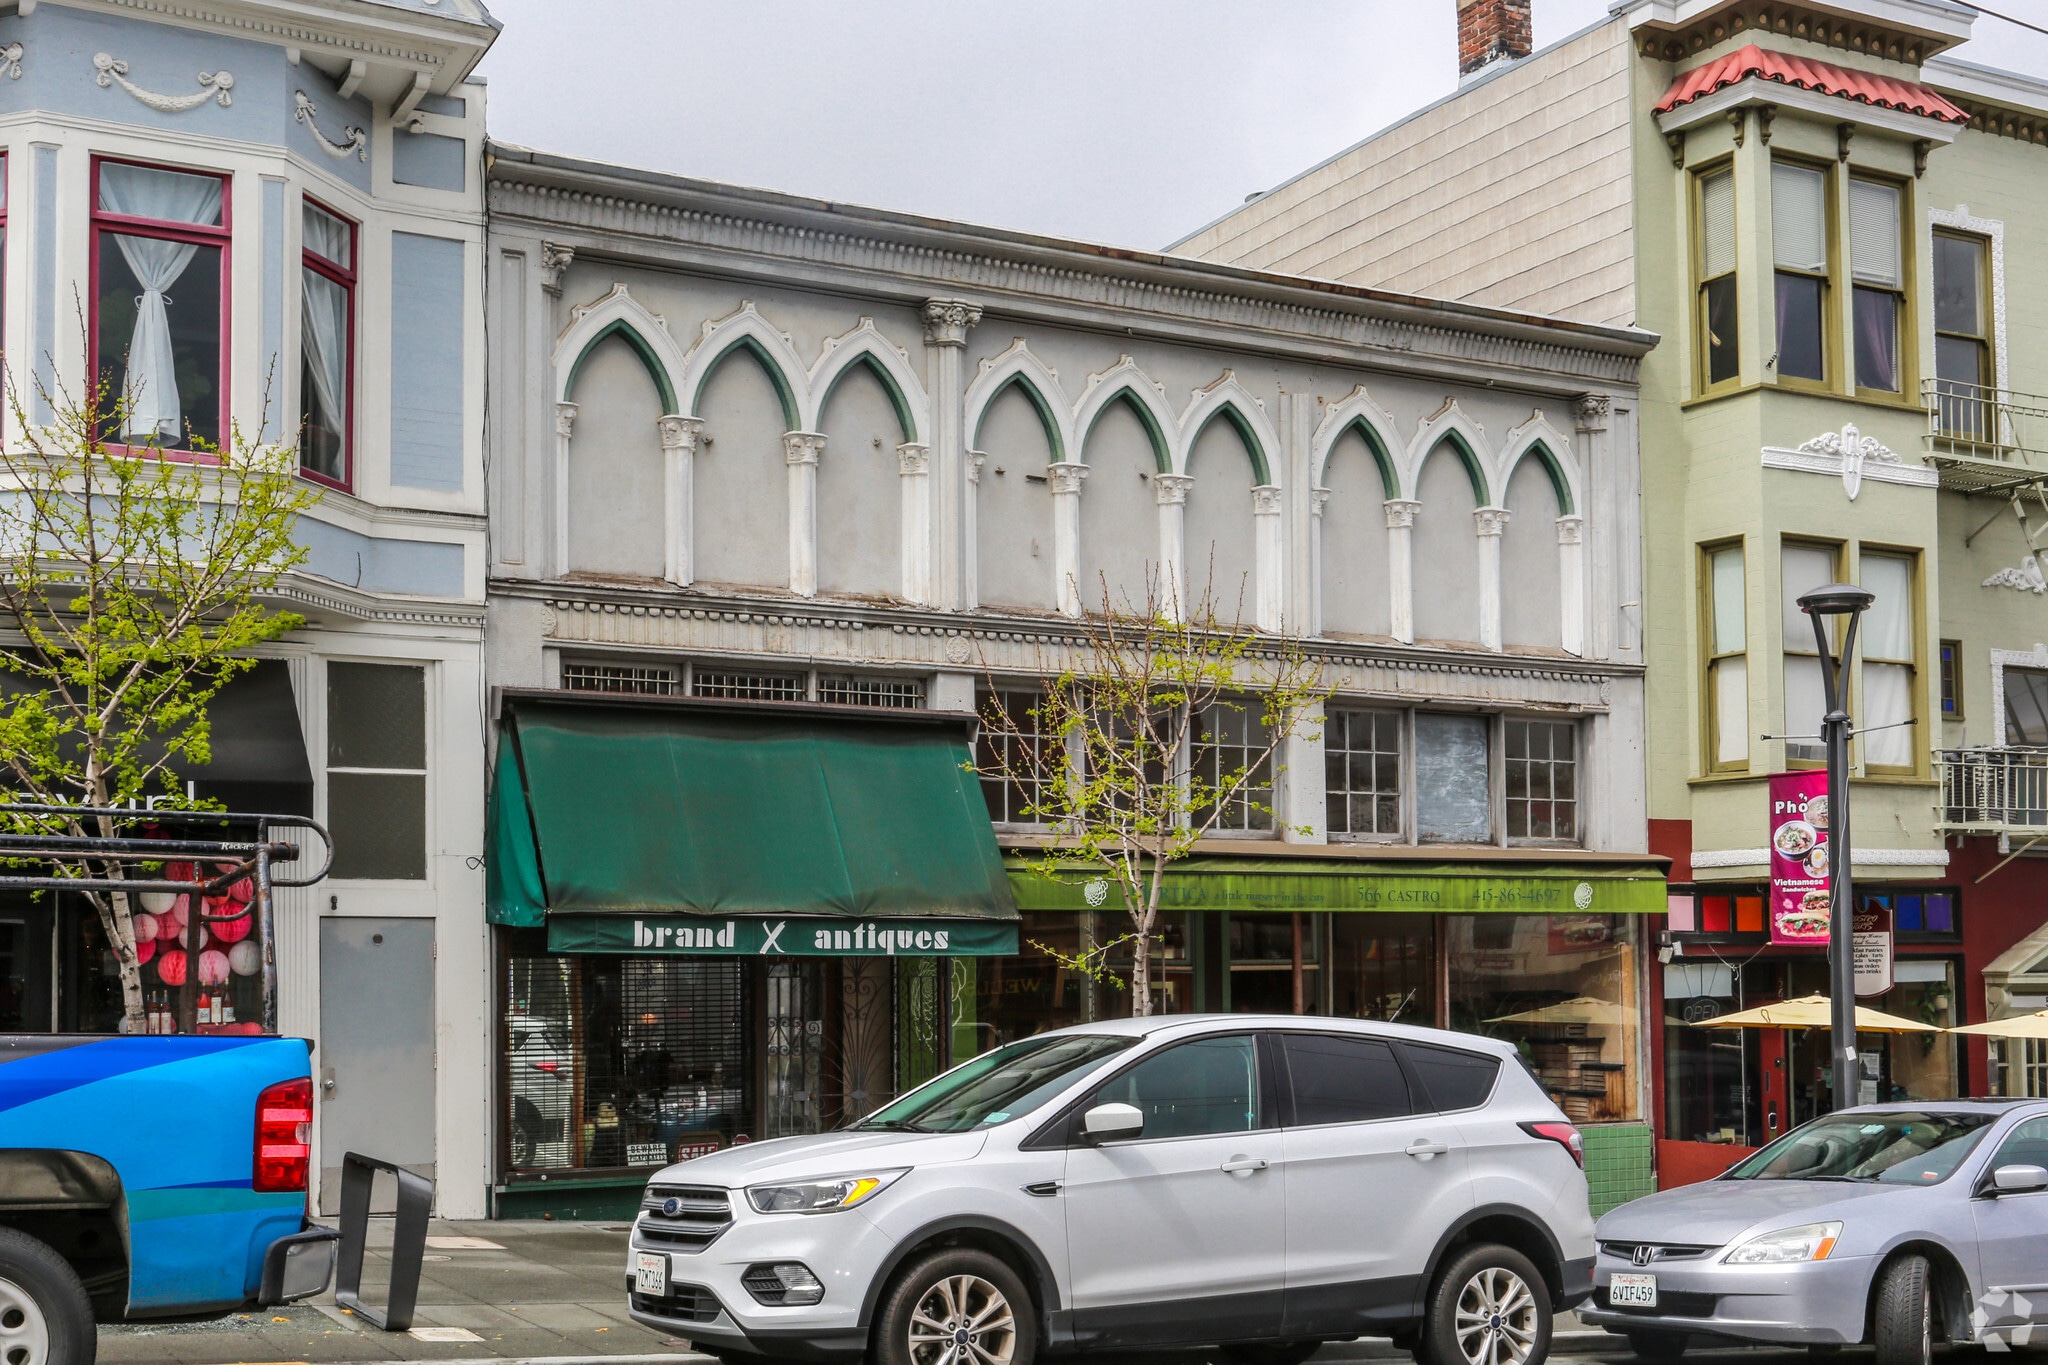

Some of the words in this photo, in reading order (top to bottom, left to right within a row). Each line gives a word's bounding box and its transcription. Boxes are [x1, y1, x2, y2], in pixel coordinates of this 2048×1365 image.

[1131, 879, 1208, 901] HRTICA
[1222, 889, 1243, 900] little
[1246, 892, 1279, 903] nursery
[1281, 891, 1291, 901] in
[1293, 890, 1306, 902] the
[1309, 892, 1326, 903] city
[1358, 886, 1382, 902] 566
[1387, 889, 1441, 902] CASTRO
[1472, 886, 1561, 903] 415-863-4697
[1774, 878, 1824, 887] Vietnamese
[633, 920, 735, 948] brand
[759, 919, 787, 955] X
[814, 922, 949, 955] antiques
[1683, 1004, 1720, 1021] OPEN
[630, 1144, 663, 1154] BEWARE
[1612, 1285, 1653, 1302] 6VIF459
